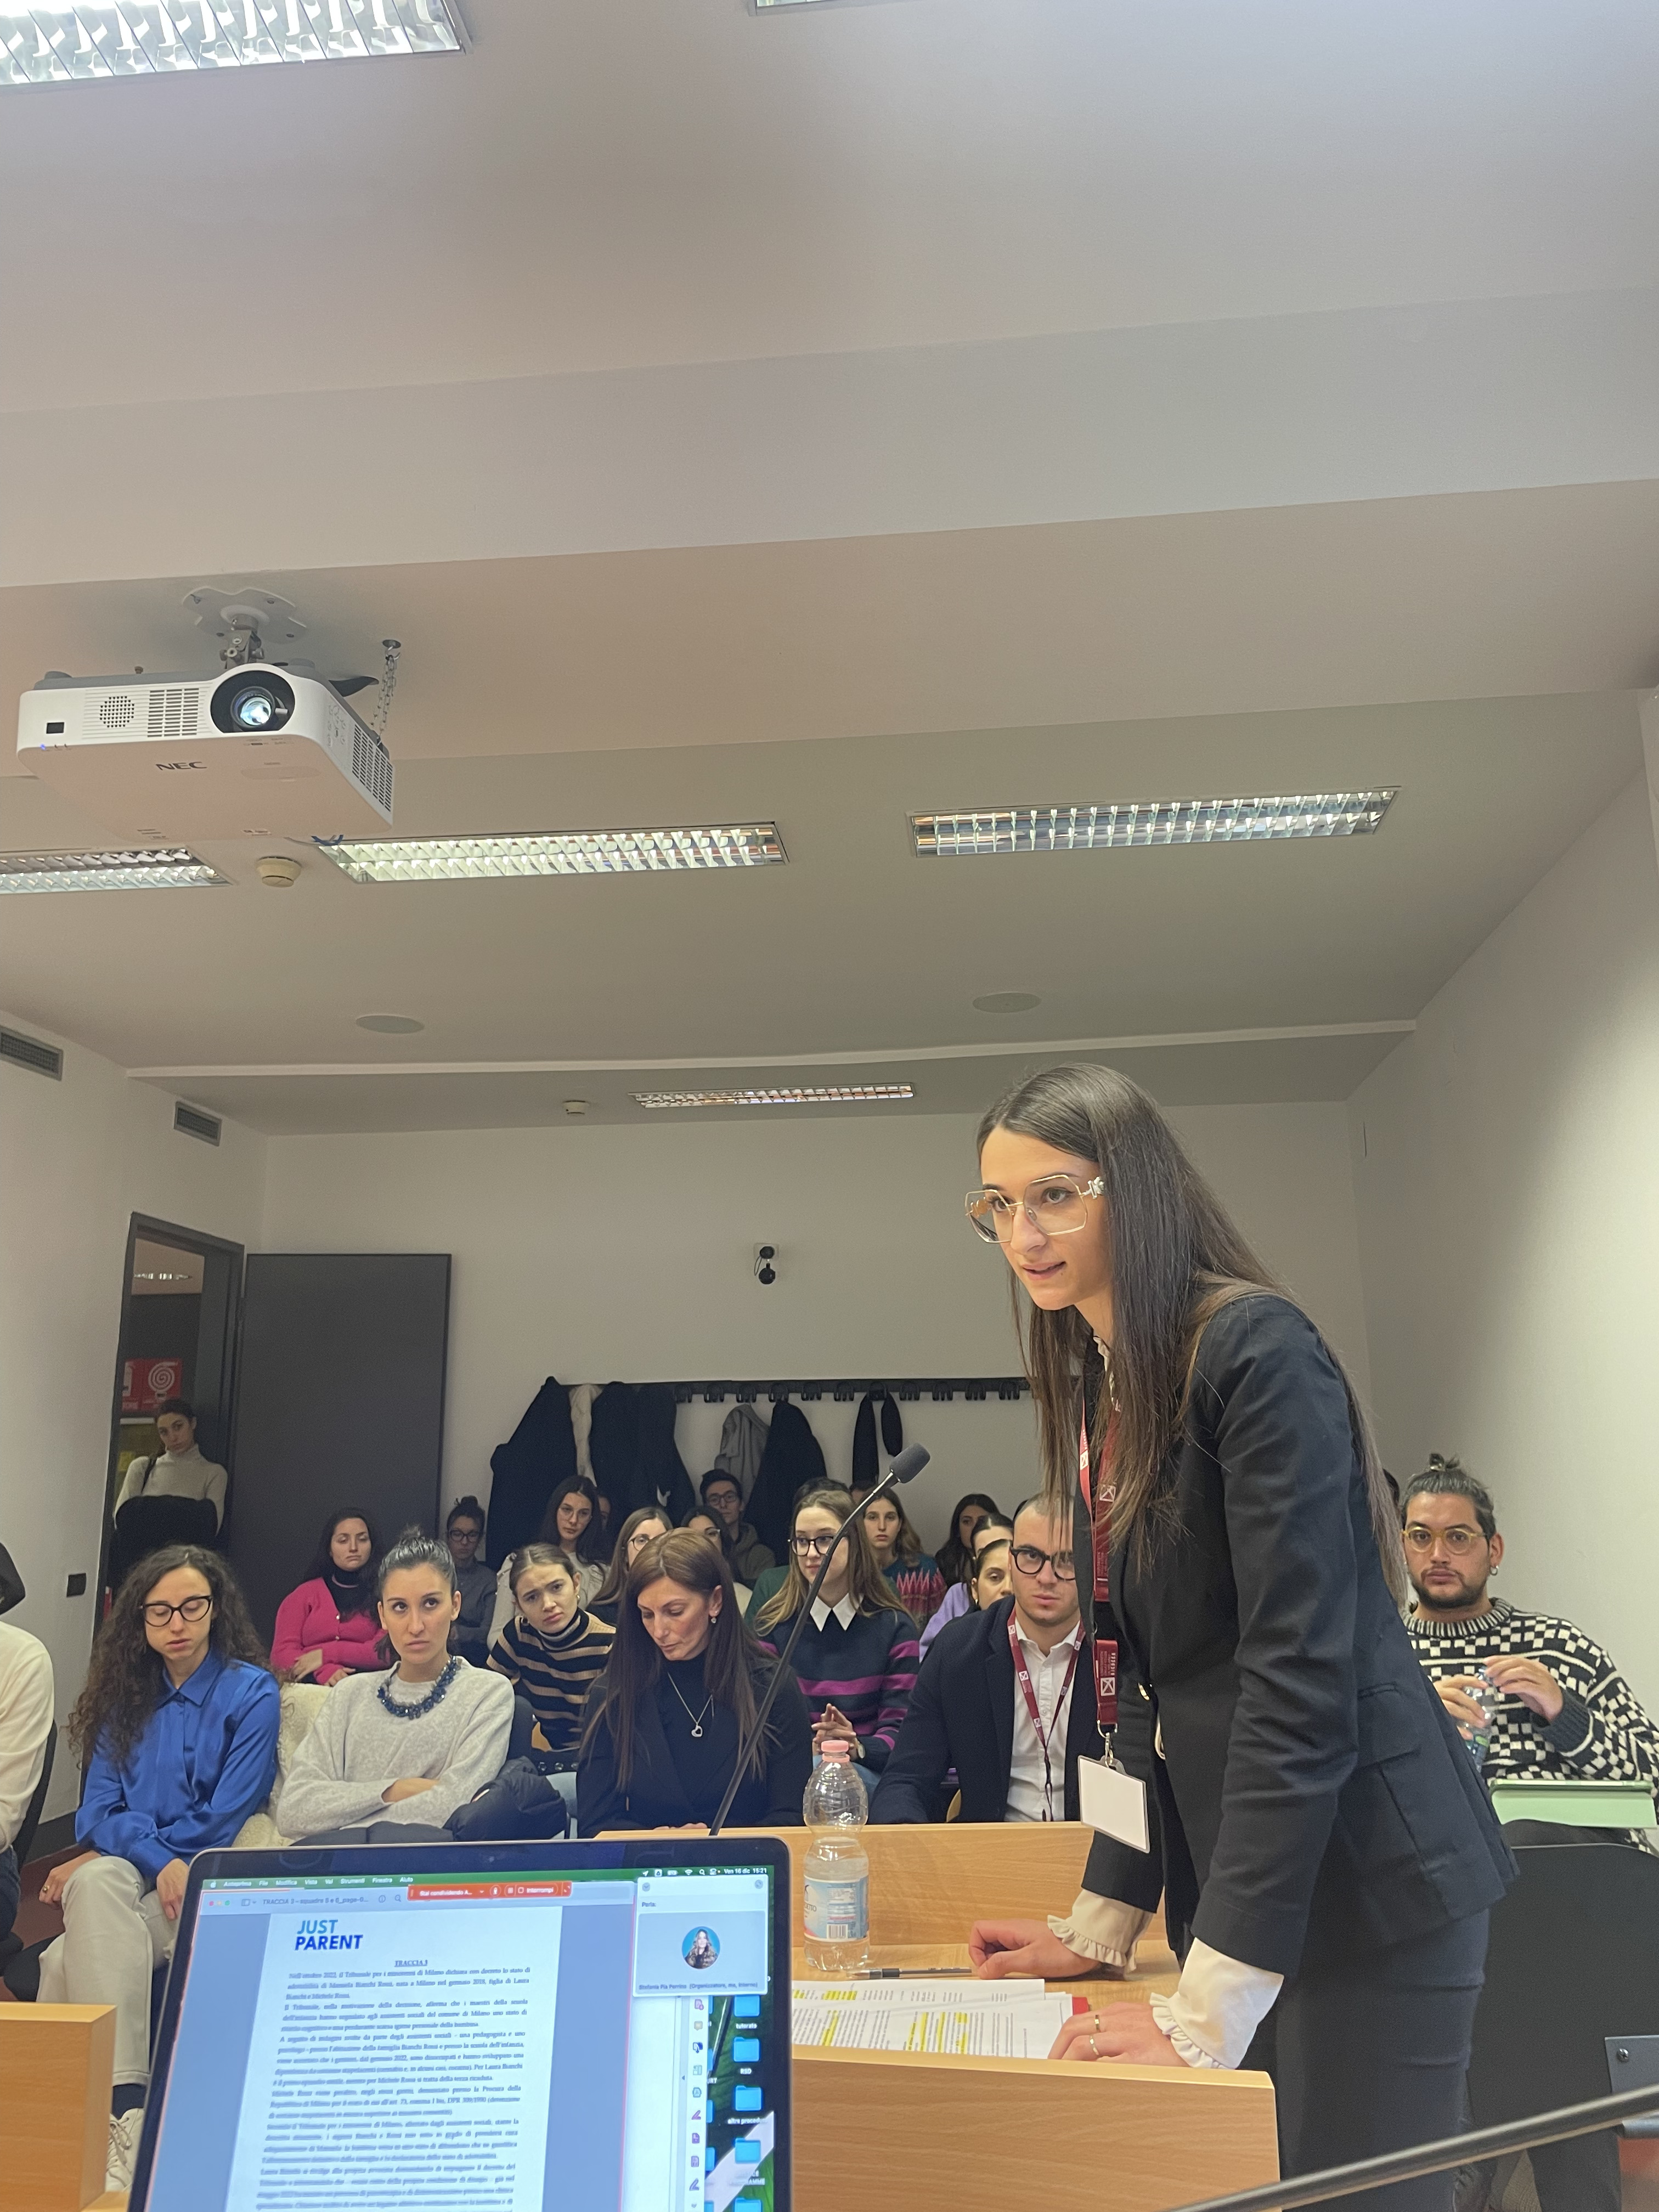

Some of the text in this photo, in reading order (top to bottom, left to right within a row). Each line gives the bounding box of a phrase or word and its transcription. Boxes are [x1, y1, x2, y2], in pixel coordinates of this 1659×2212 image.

[155, 761, 207, 771] NEC
[297, 1919, 338, 1935] JUST
[295, 1934, 363, 1951] PARENT
